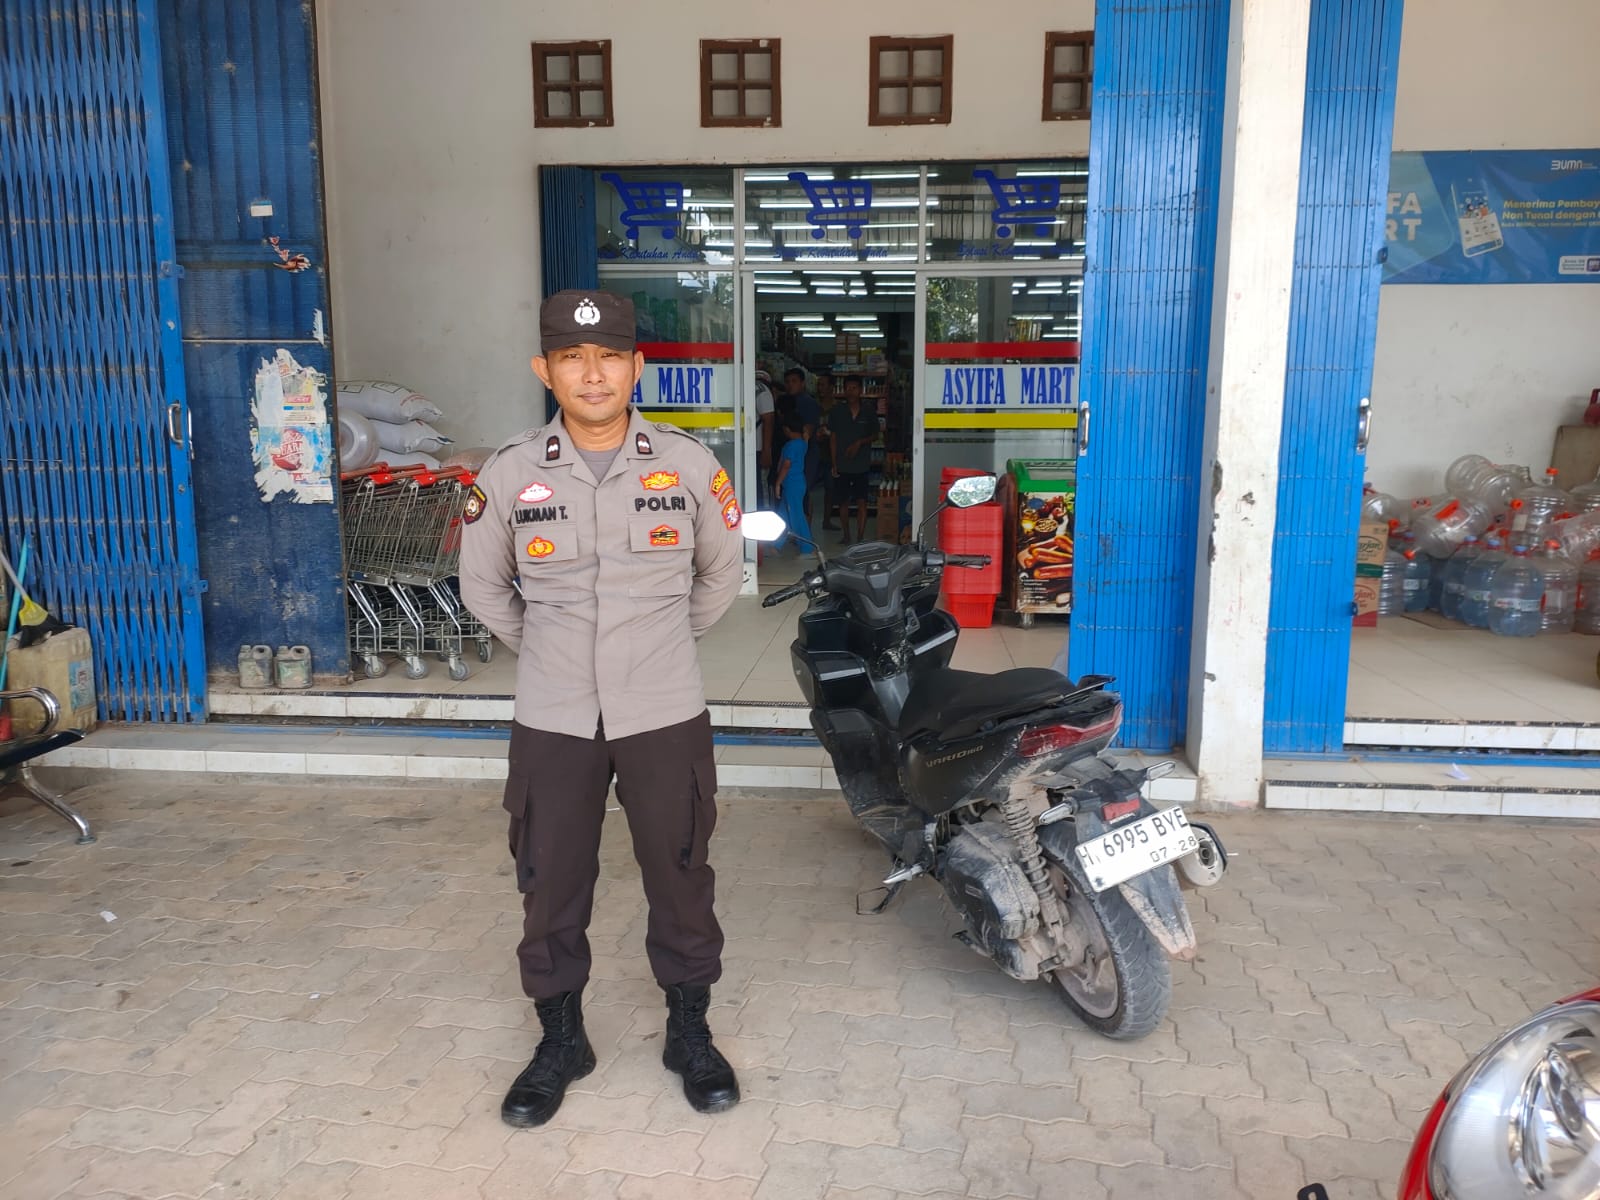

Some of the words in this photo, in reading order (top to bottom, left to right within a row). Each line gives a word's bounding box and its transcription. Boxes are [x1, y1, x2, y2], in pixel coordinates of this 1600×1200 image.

[1504, 199, 1555, 208] Menerima
[1526, 211, 1553, 219] Tunai
[1555, 211, 1596, 221] dengan
[658, 367, 714, 404] MART
[942, 368, 1006, 405] ASYIFA
[1020, 367, 1075, 404] MART
[634, 496, 686, 512] POLRI
[514, 506, 557, 524] LUKMAN
[558, 505, 568, 520] T.
[1103, 823, 1150, 857] 6995
[1151, 808, 1189, 837] BYE
